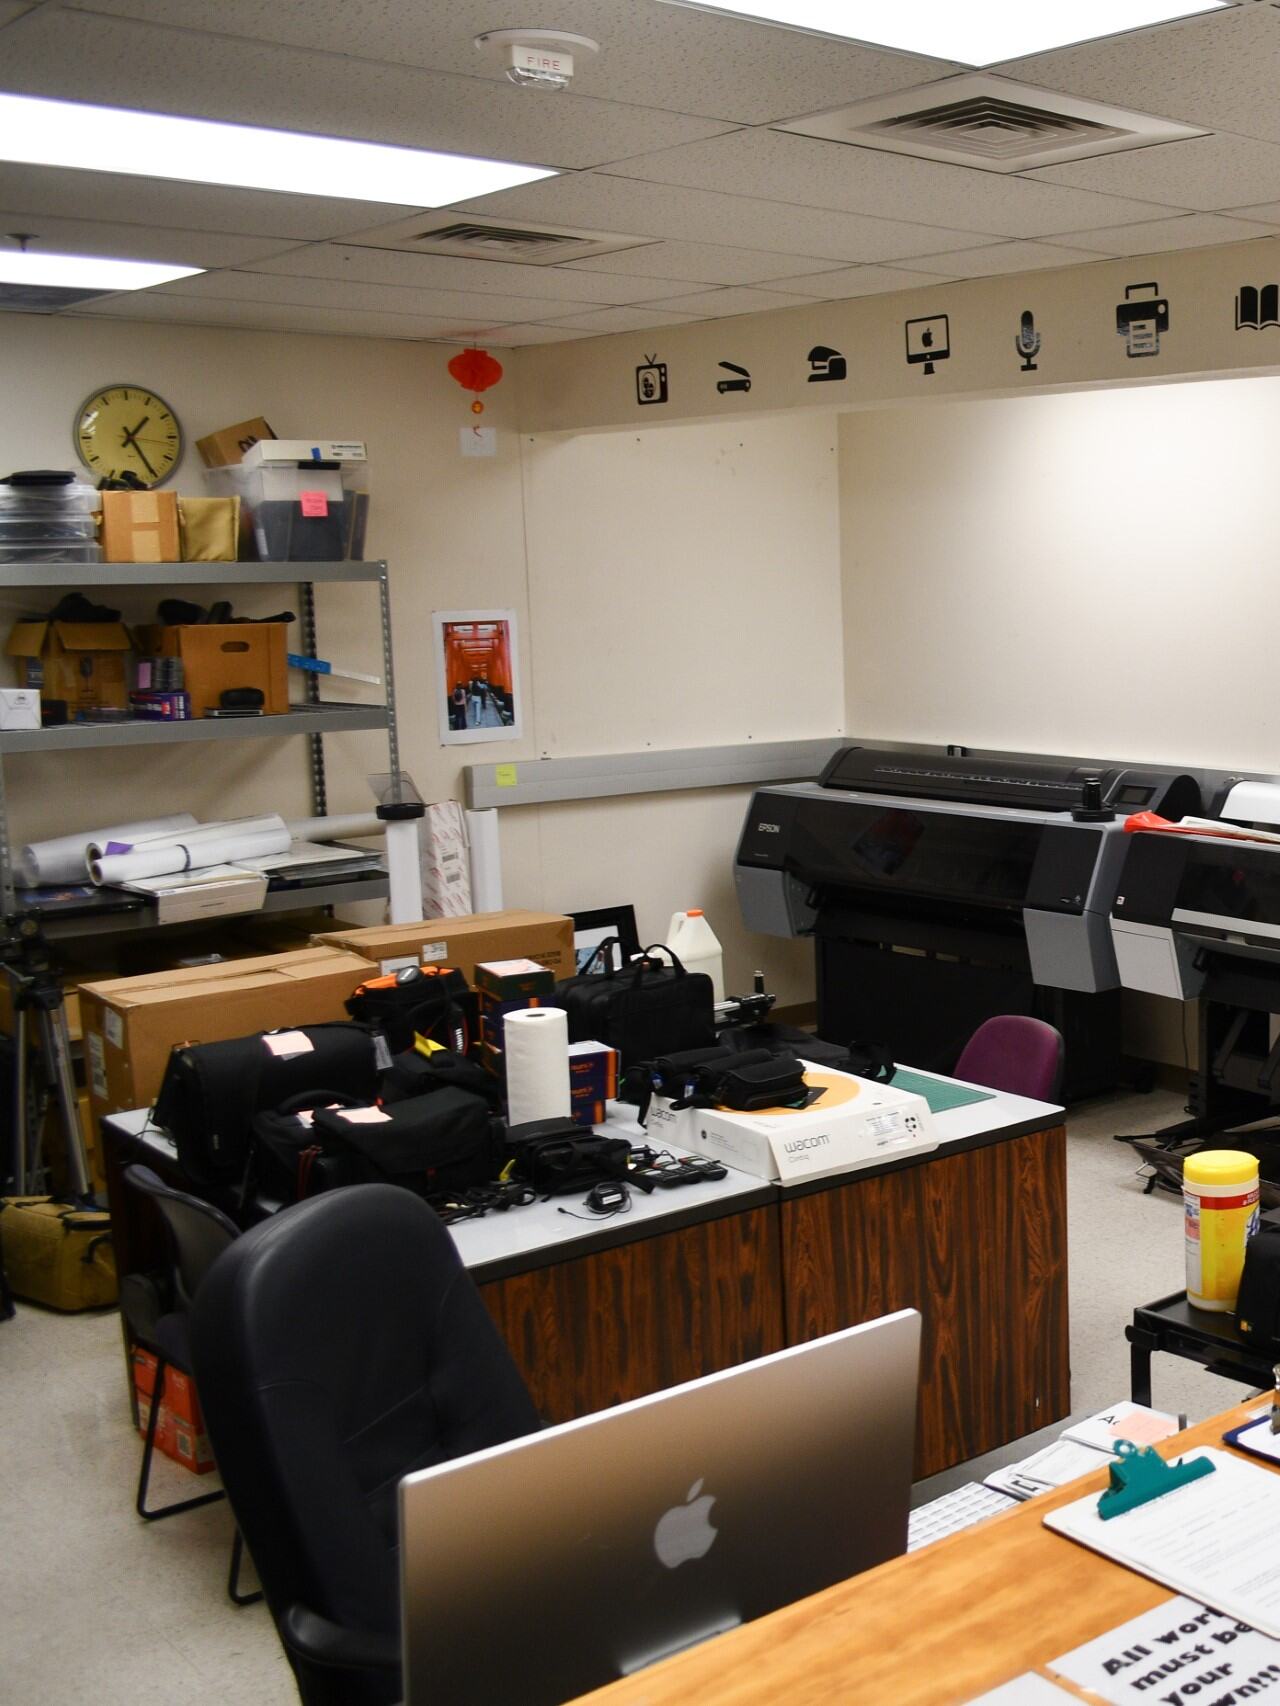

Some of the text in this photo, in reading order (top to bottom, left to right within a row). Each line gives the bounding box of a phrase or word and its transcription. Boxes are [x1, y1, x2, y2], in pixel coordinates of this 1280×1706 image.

[527, 56, 561, 71] FIRE
[758, 822, 780, 833] EPSON
[784, 1134, 830, 1153] wacom
[1101, 1644, 1154, 1677] All
[1131, 1620, 1254, 1692] must be
[1160, 1660, 1235, 1706] your
